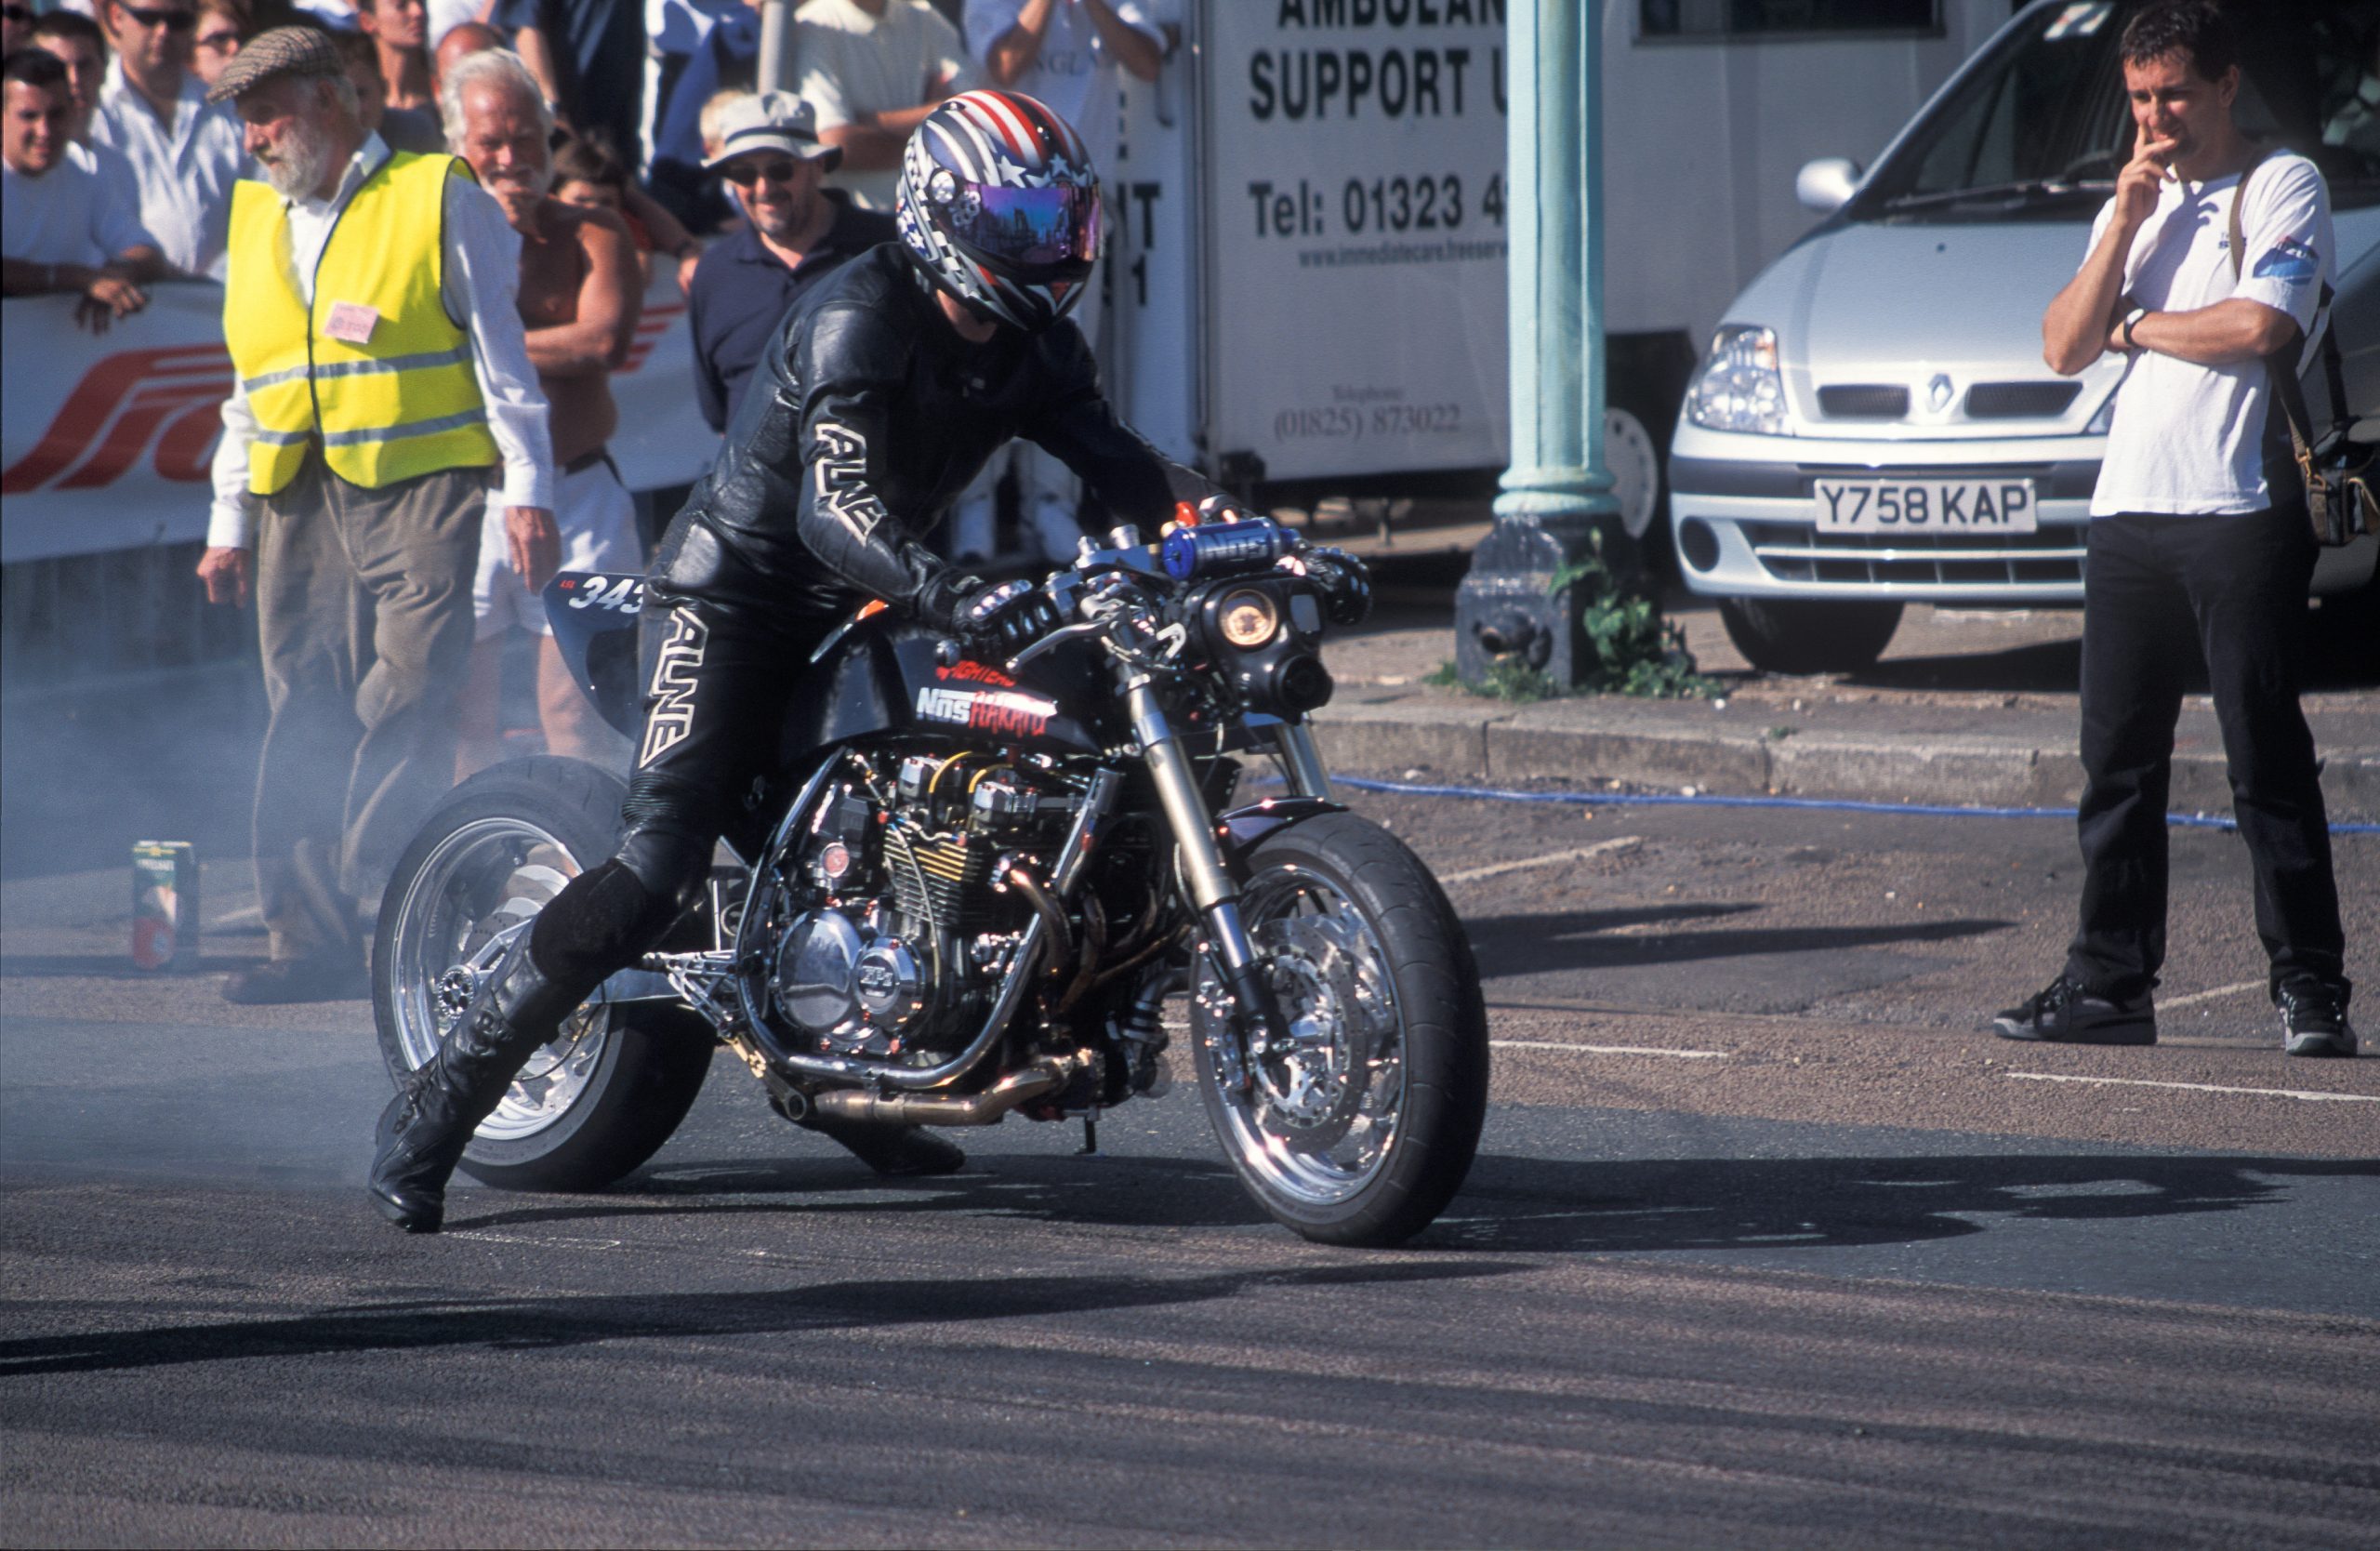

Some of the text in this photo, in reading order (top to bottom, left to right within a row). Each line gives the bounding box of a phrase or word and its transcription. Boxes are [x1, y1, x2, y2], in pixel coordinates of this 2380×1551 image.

[1250, 48, 1469, 120] SUPPORT
[1249, 172, 1507, 237] Tel: 01323 4
[1274, 403, 1461, 444] (01825) 873022
[1821, 484, 2029, 524] Y758 KAP
[568, 576, 644, 614] 343
